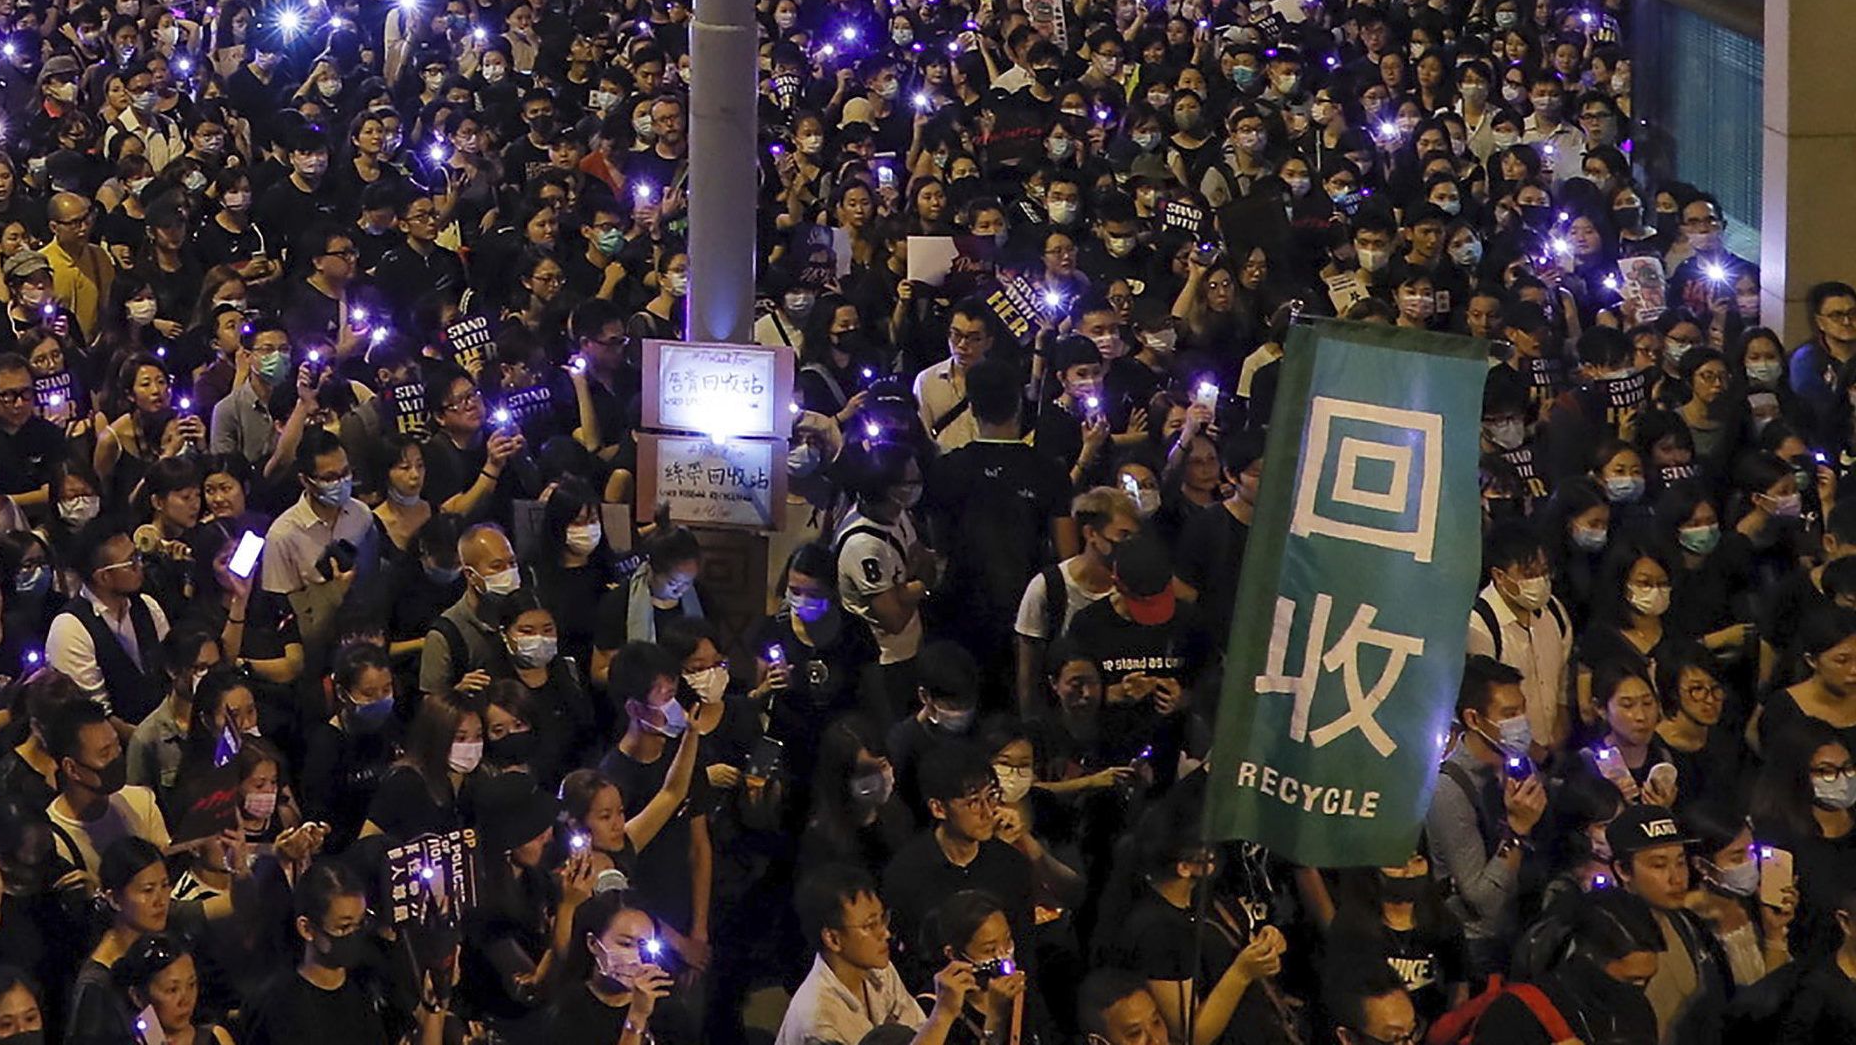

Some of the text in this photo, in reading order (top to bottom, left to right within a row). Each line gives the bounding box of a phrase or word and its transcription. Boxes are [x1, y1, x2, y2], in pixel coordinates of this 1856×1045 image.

[1166, 202, 1203, 220] STAND
[1166, 213, 1199, 231] WITH
[1005, 284, 1037, 321] WITH
[986, 290, 1029, 338] HER
[447, 316, 488, 339] STAND
[452, 329, 491, 351] WITH
[507, 387, 551, 408] STAND
[664, 461, 769, 490] 絲帶回收站
[1255, 396, 1443, 758] 回收
[1115, 656, 1147, 670] stand
[1148, 657, 1163, 669] as
[1237, 760, 1381, 819] RECYCLE
[462, 828, 477, 849] OP
